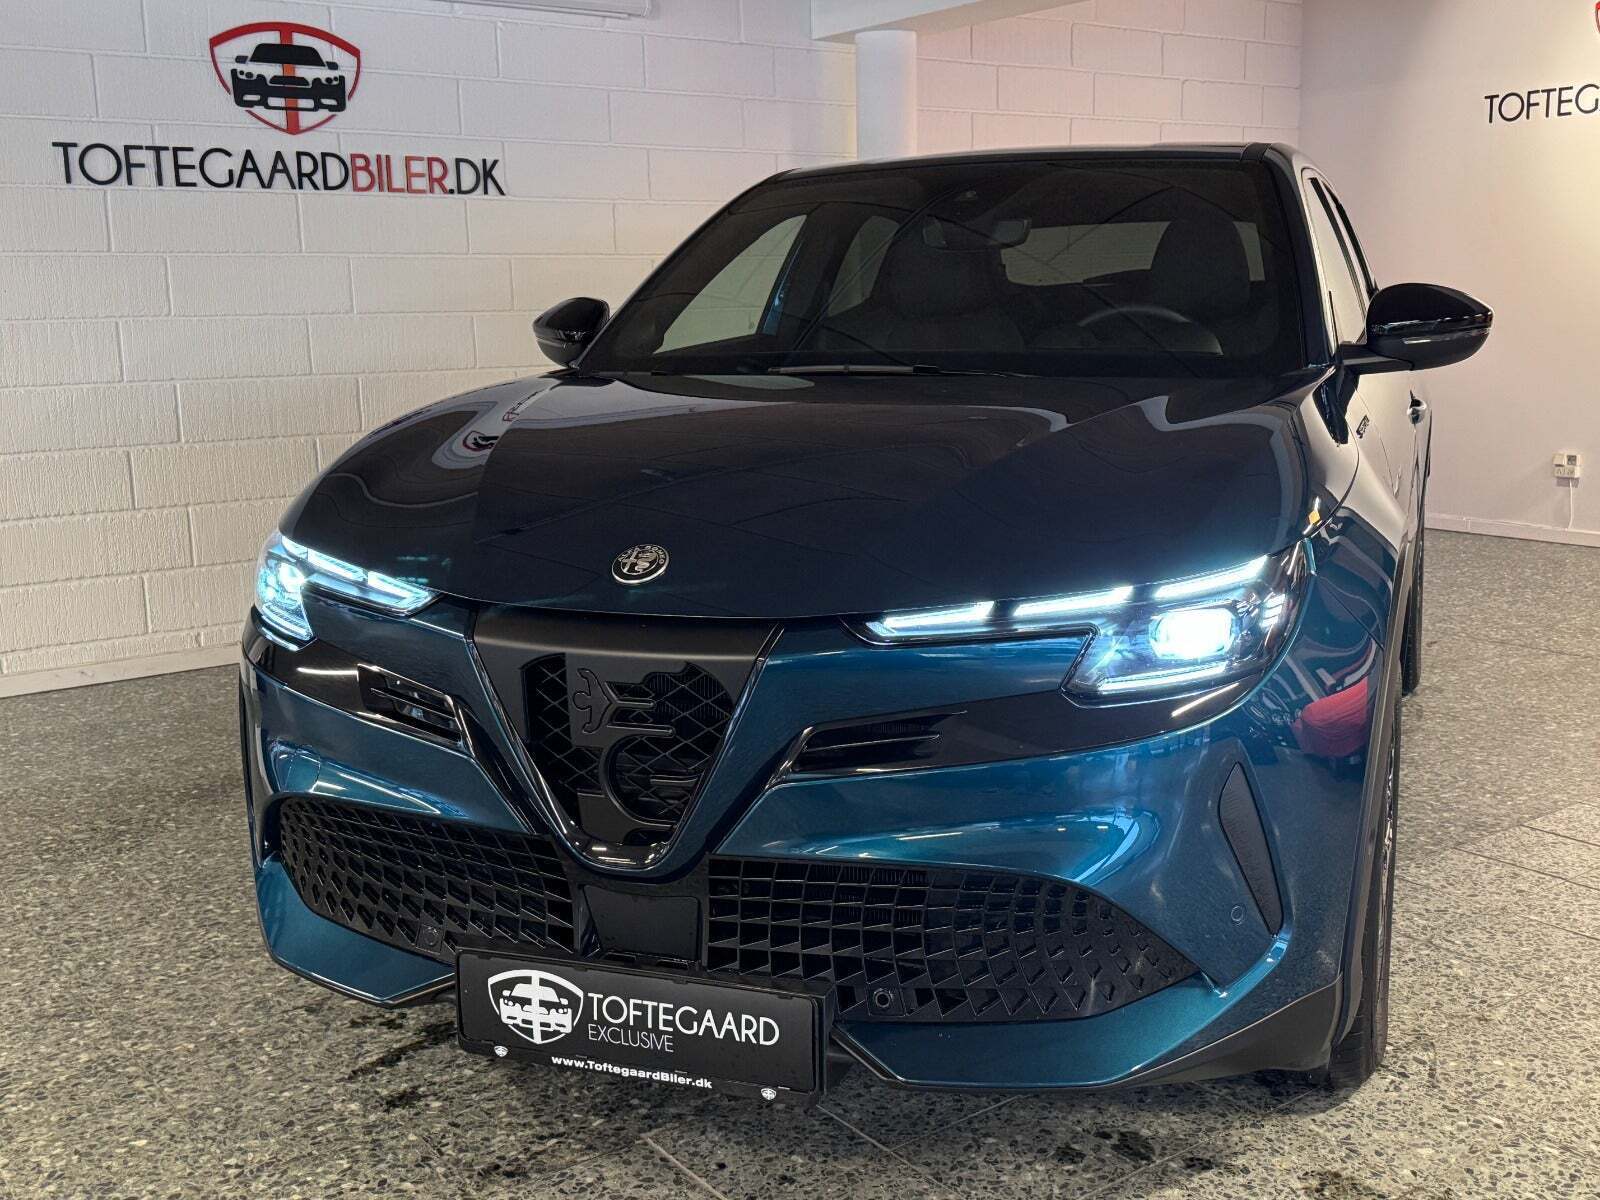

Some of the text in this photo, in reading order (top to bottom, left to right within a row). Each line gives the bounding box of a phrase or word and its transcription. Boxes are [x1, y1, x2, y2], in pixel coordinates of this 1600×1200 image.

[1484, 84, 1600, 124] TOFTEG
[52, 141, 506, 195] TOFTEGAARDBILER.DK
[588, 993, 780, 1046] TOFTEGAARD
[588, 1024, 675, 1053] EXCLUSIVE
[551, 1056, 713, 1089] www.ToftegaardBiler.dk
